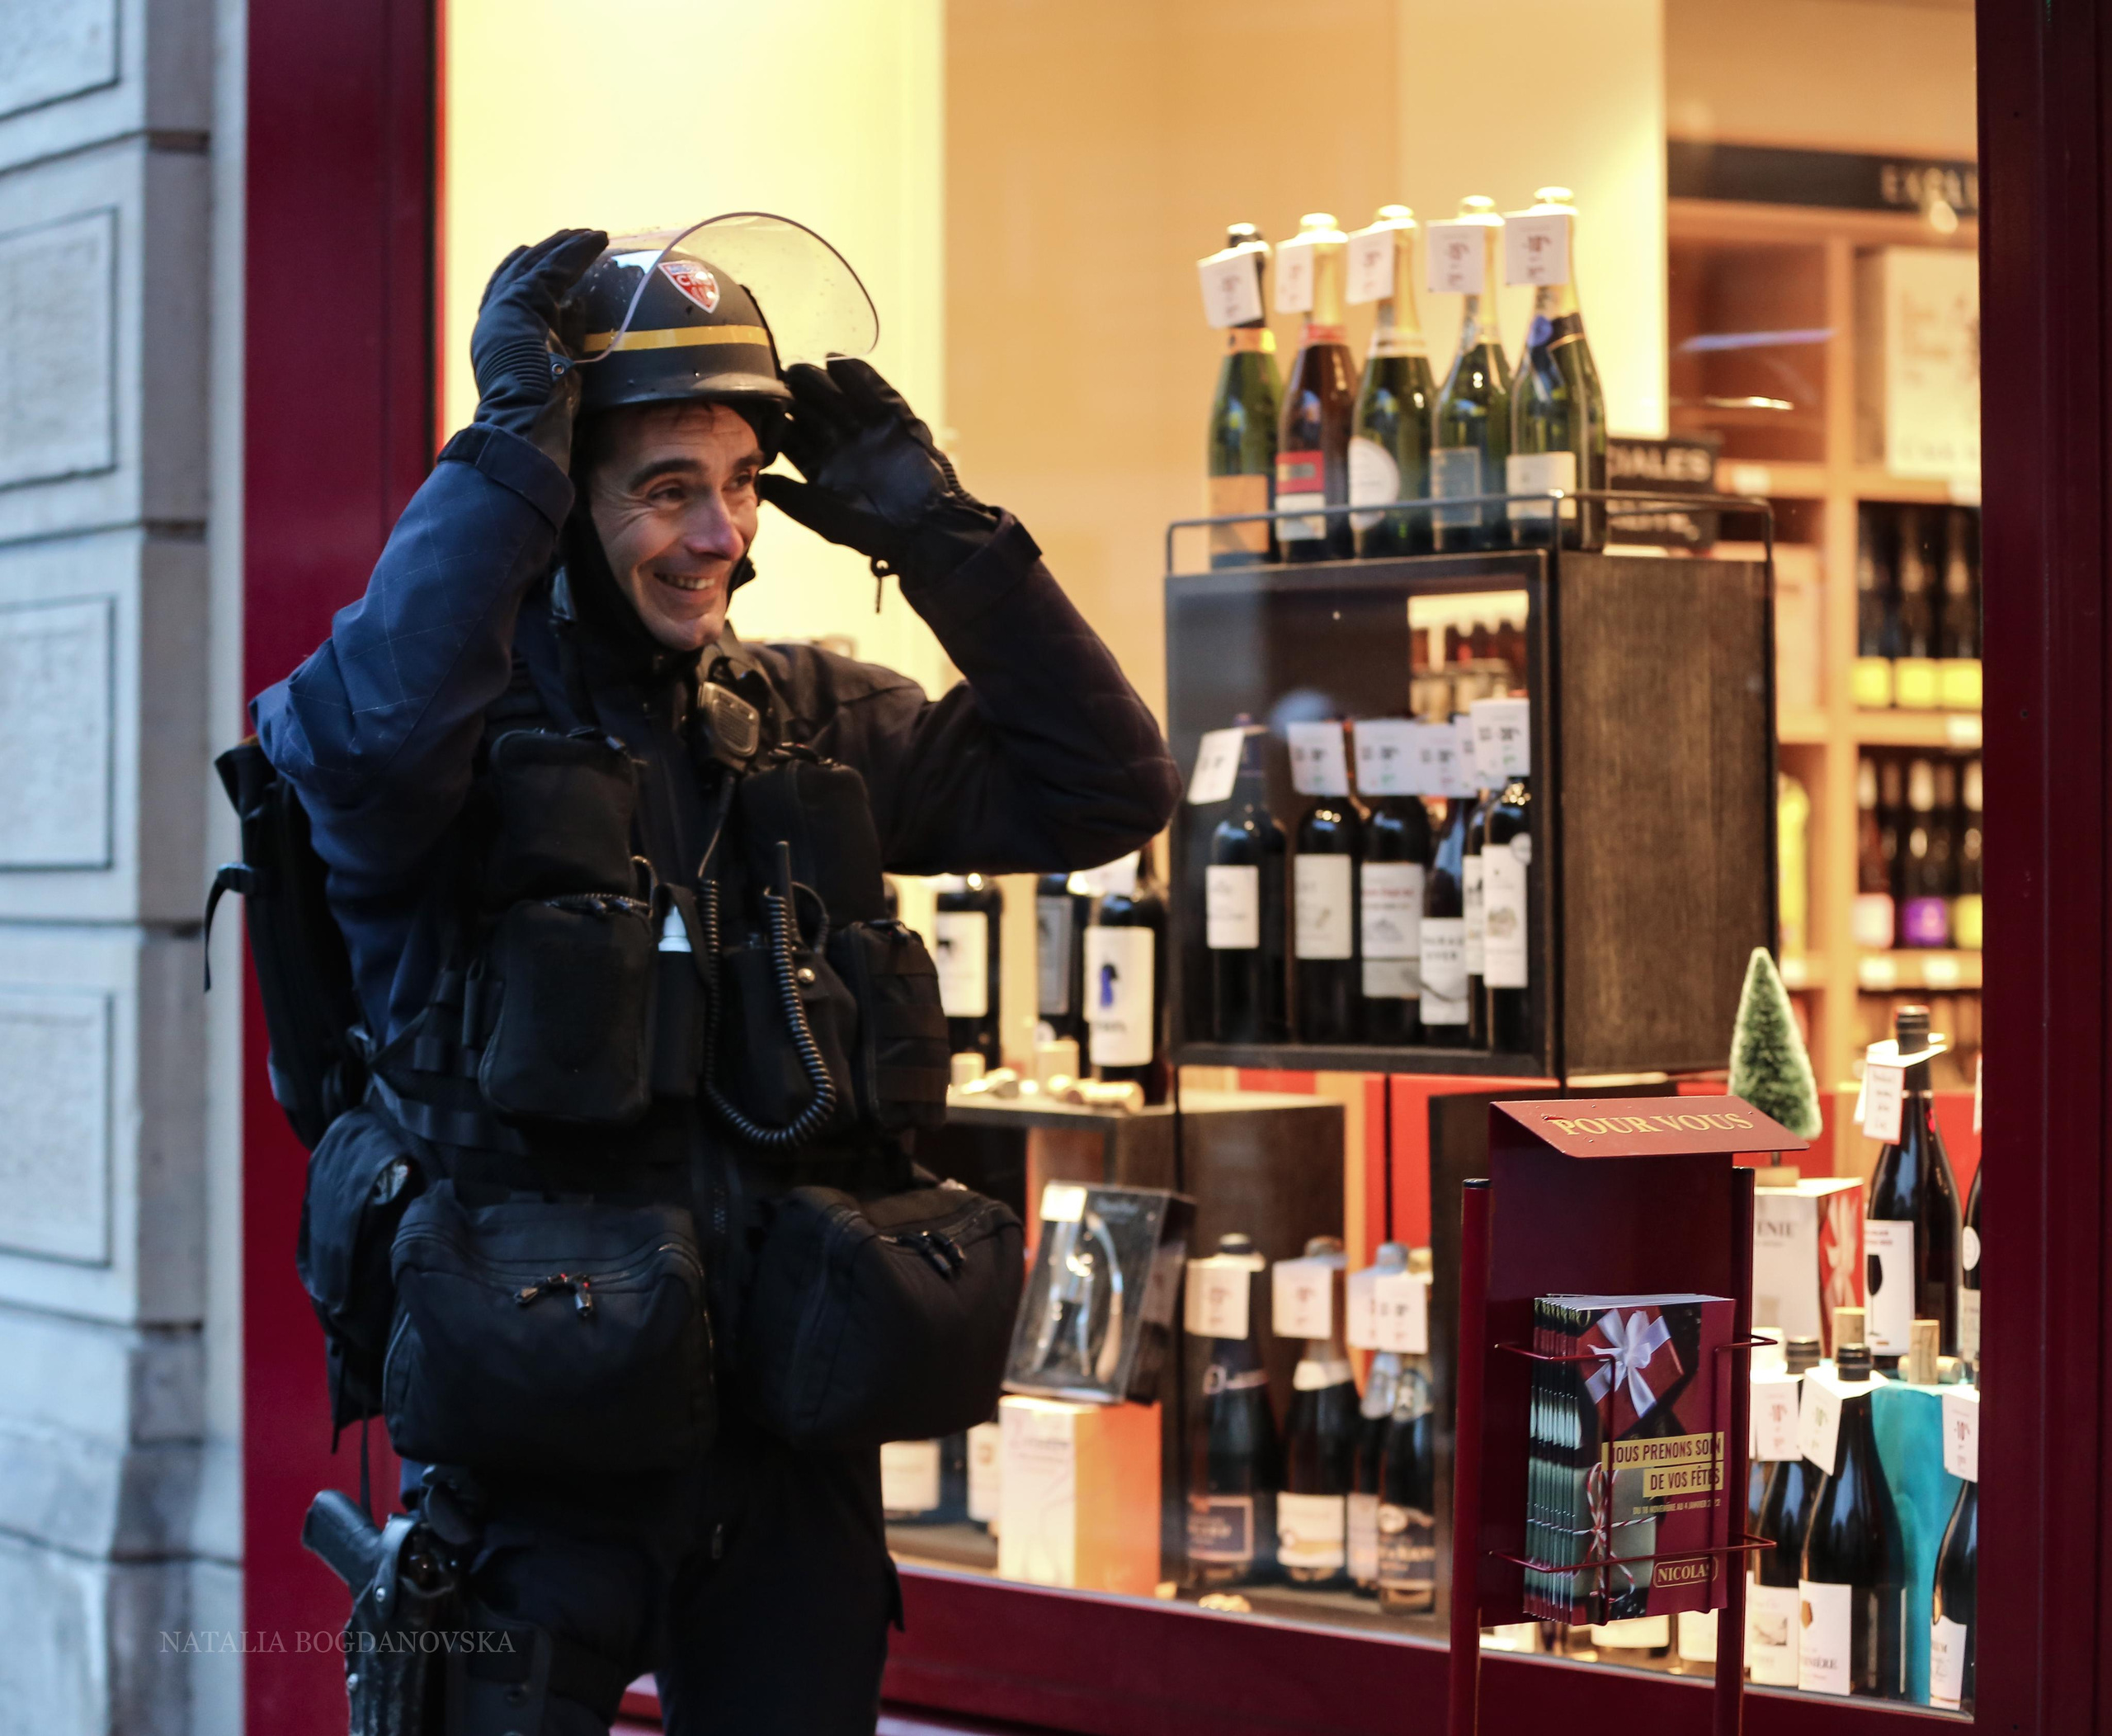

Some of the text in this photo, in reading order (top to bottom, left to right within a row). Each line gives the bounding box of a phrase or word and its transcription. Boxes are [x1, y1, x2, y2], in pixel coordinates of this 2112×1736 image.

[1608, 444, 1712, 483] IALES
[1549, 1113, 1754, 1135] POUR VOUS
[1643, 1441, 1692, 1460] PRENONS
[1651, 1474, 1664, 1490] DE
[1668, 1471, 1687, 1488] VOS
[1657, 1564, 1709, 1582] NICOLA
